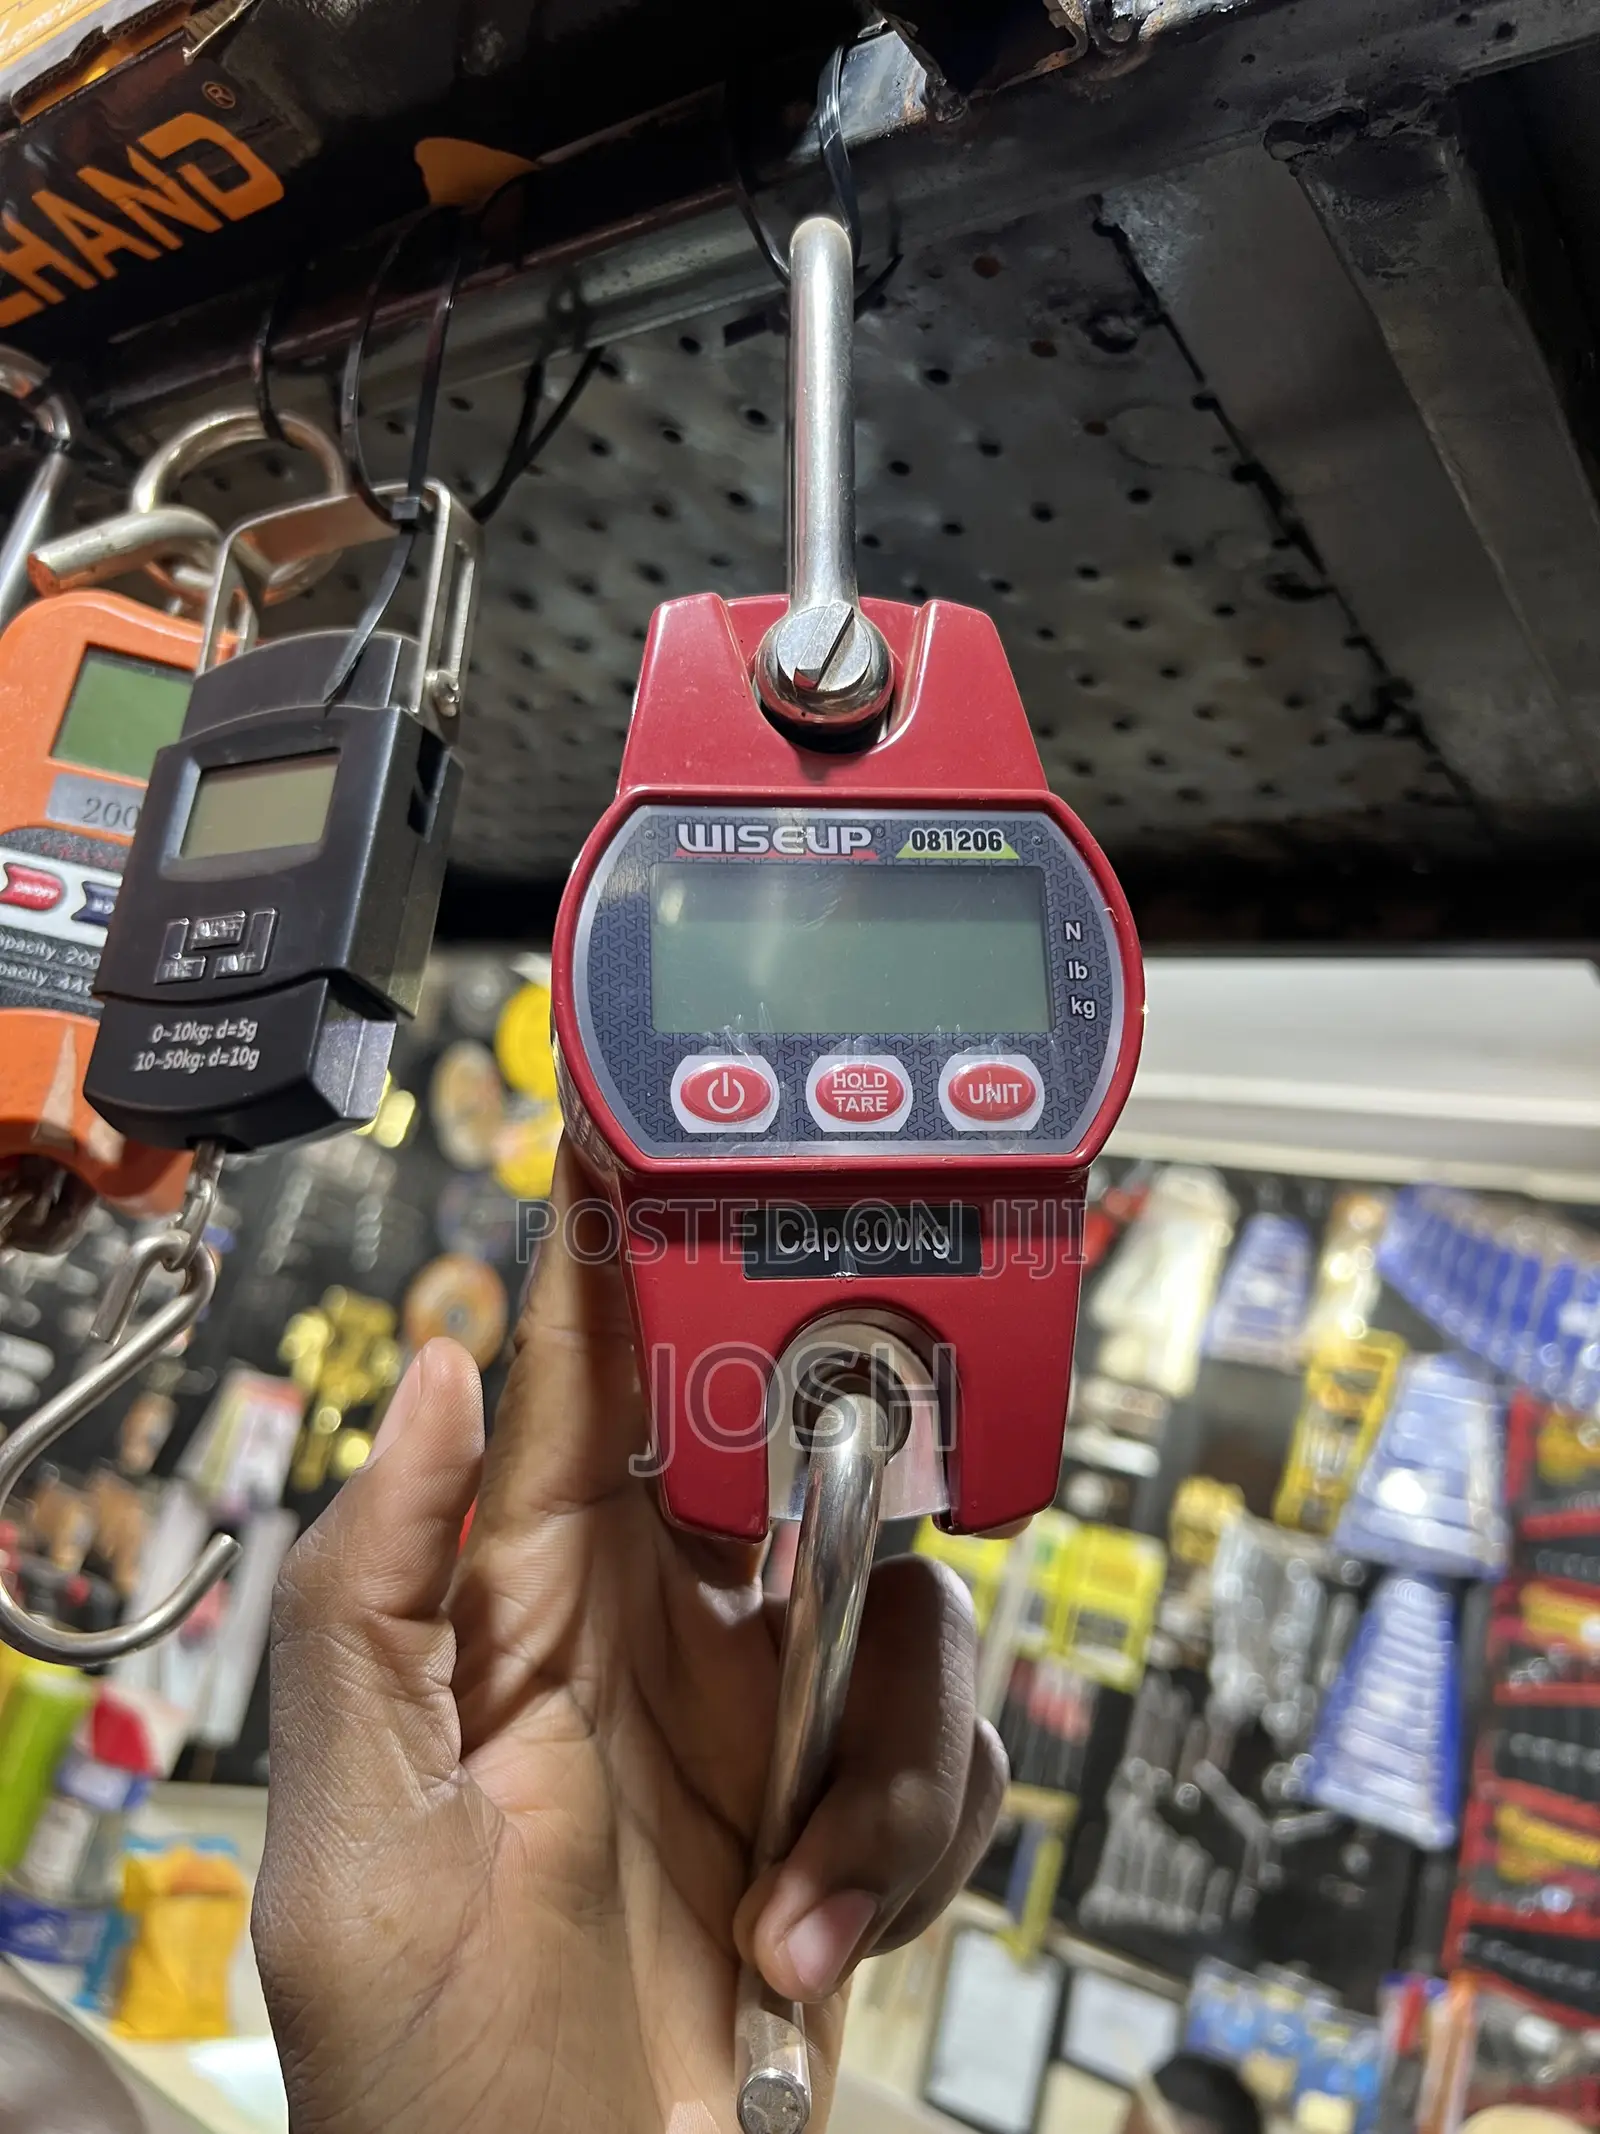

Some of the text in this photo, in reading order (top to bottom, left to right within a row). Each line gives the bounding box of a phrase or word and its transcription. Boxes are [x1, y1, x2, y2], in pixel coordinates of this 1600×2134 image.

[0, 111, 285, 328] HAND
[678, 823, 873, 855] WISEUP
[911, 828, 1003, 853] 081206
[1065, 922, 1082, 940] N
[1068, 961, 1088, 980] lb
[1070, 996, 1096, 1020] kg
[216, 1017, 258, 1043] d=5g
[208, 1045, 260, 1071] d=10g
[833, 1072, 888, 1090] HOLD
[834, 1096, 888, 1113] TARE
[968, 1083, 1023, 1105] UNIT
